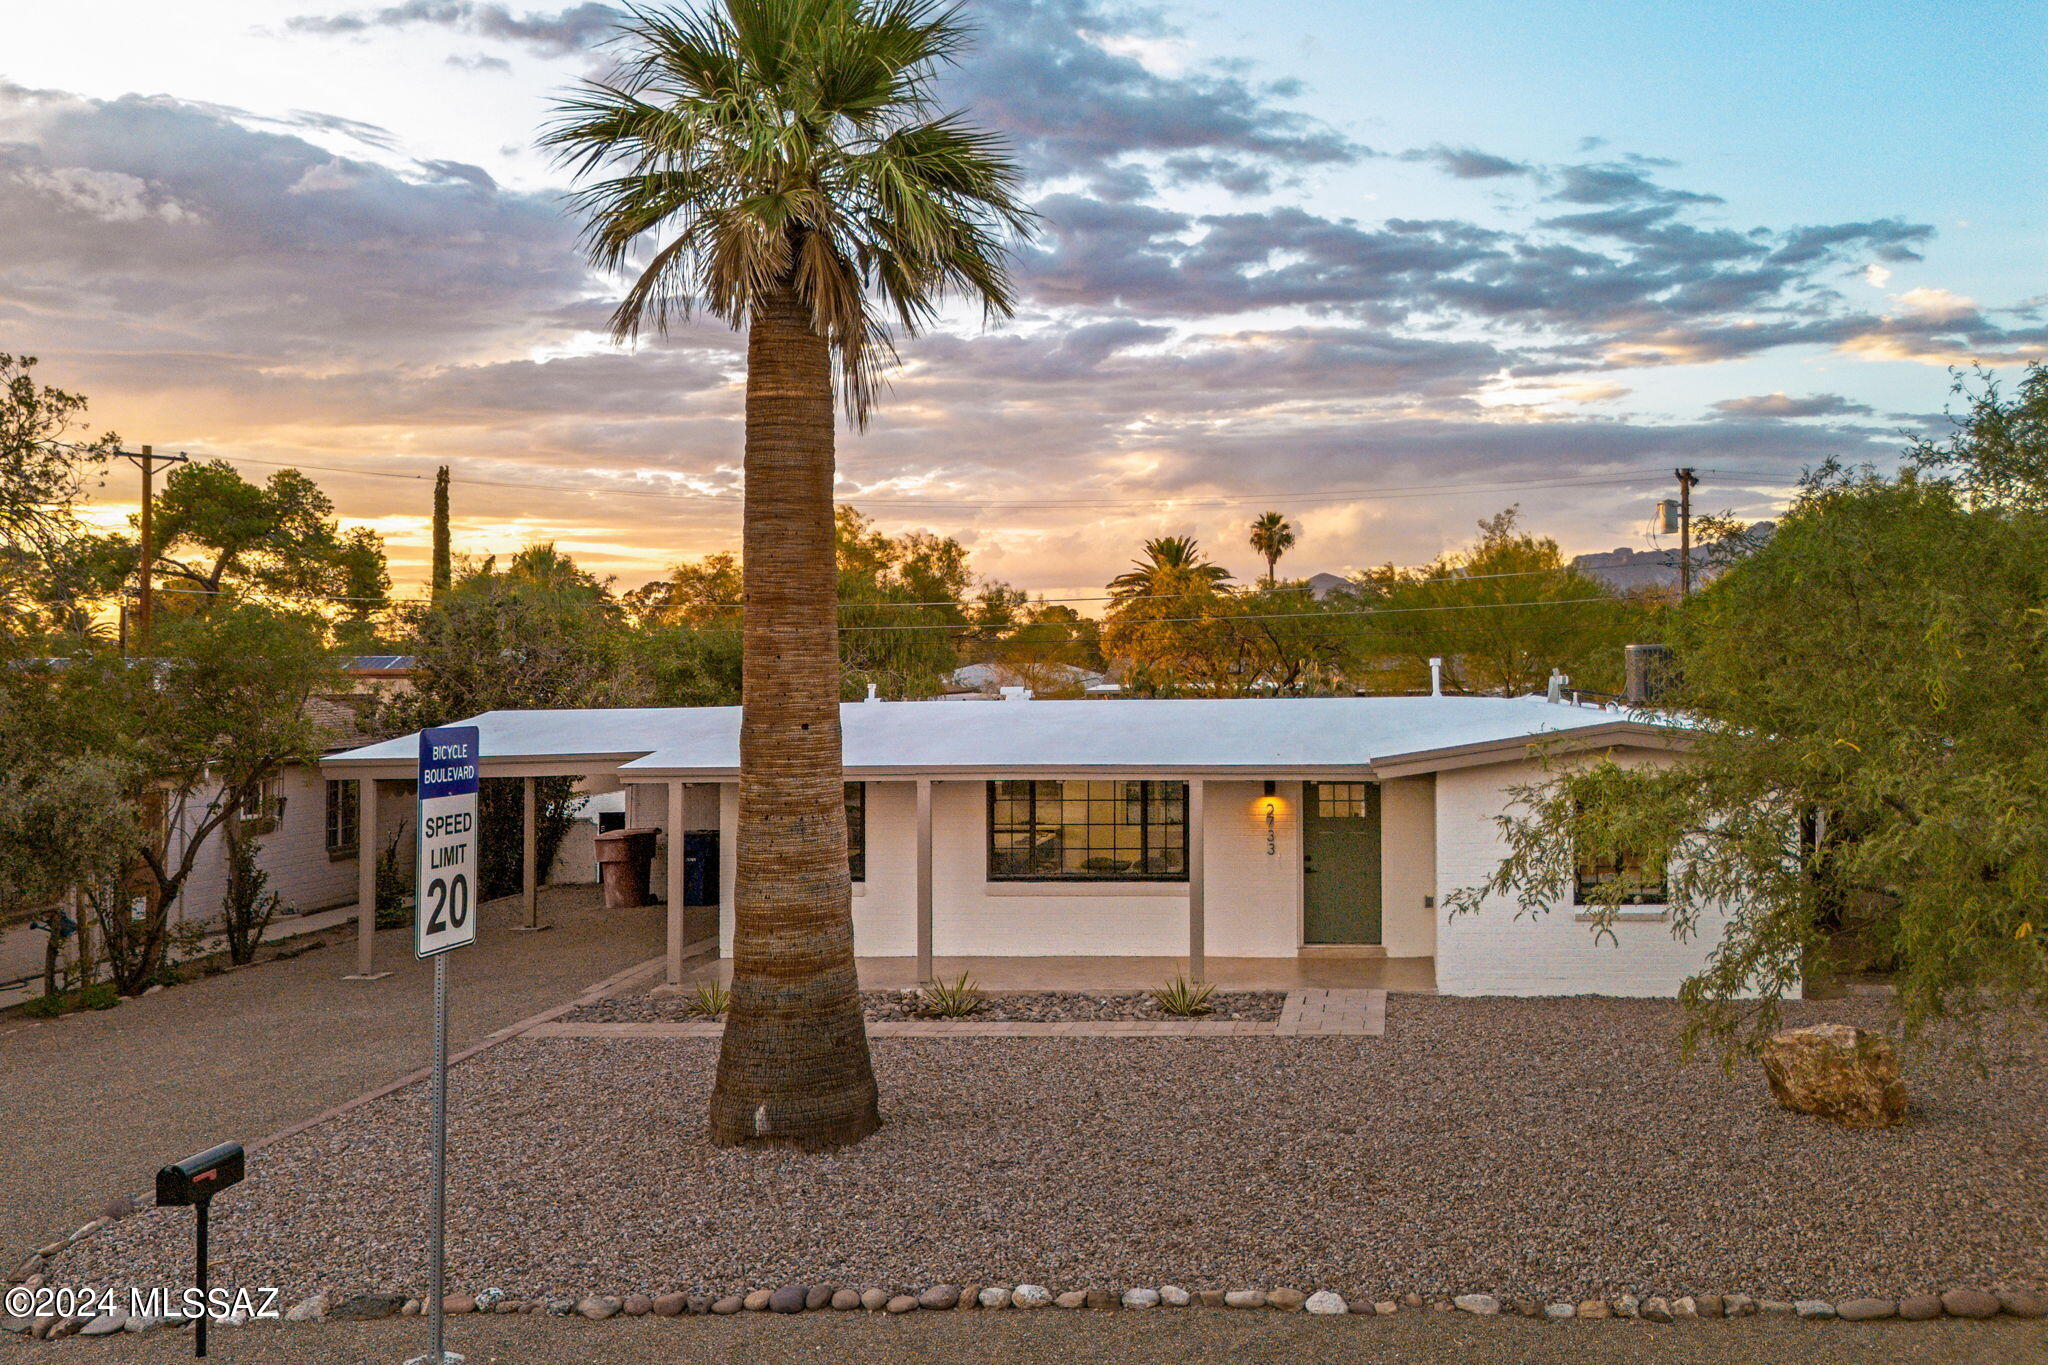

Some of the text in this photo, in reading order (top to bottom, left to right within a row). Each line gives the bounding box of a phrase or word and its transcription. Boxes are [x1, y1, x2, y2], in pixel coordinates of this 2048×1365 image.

[433, 744, 468, 760] BICYCLE
[424, 766, 474, 784] BOULEVARD
[425, 813, 471, 838] SPEED
[1266, 803, 1275, 856] 2733
[431, 844, 466, 869] LIMIT
[426, 874, 467, 935] 20
